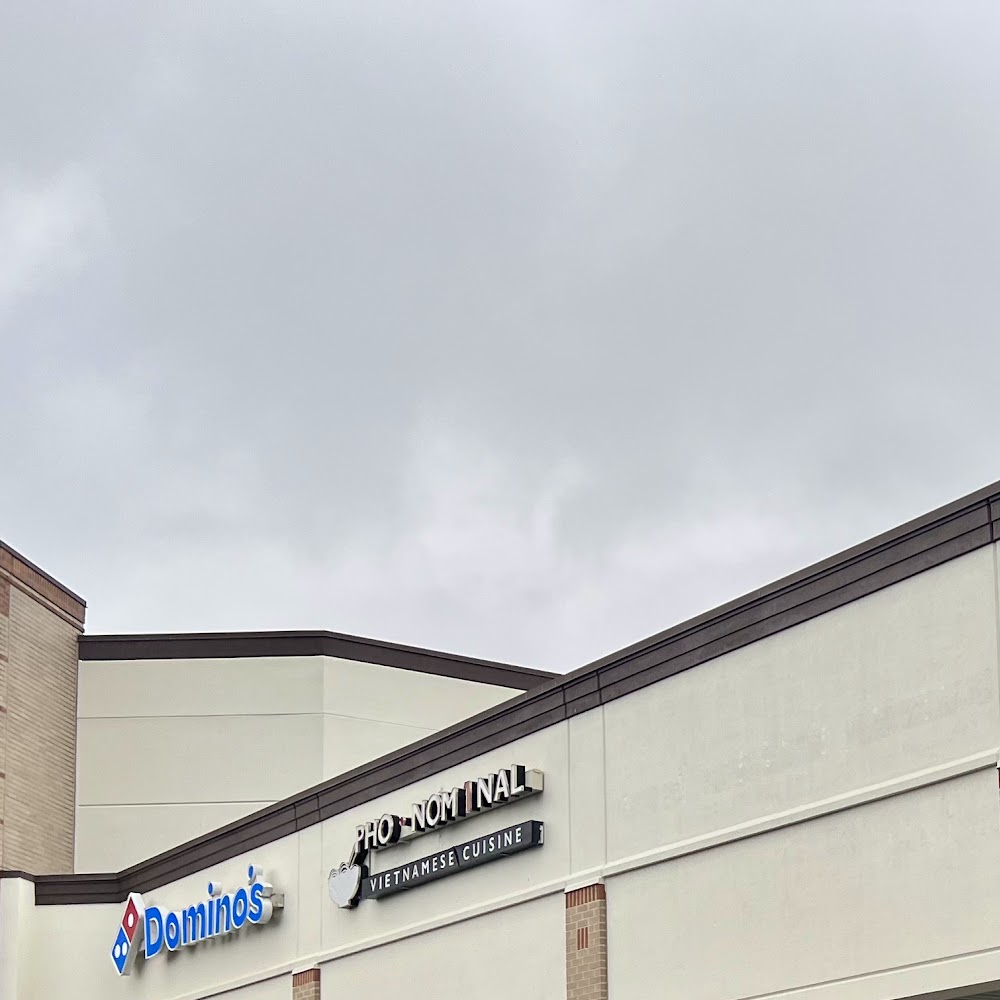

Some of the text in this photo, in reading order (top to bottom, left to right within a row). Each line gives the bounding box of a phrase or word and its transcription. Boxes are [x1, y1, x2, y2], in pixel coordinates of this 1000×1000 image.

[370, 827, 523, 893] VIETNAMESE CUISINE
[144, 863, 266, 959] Domino's
